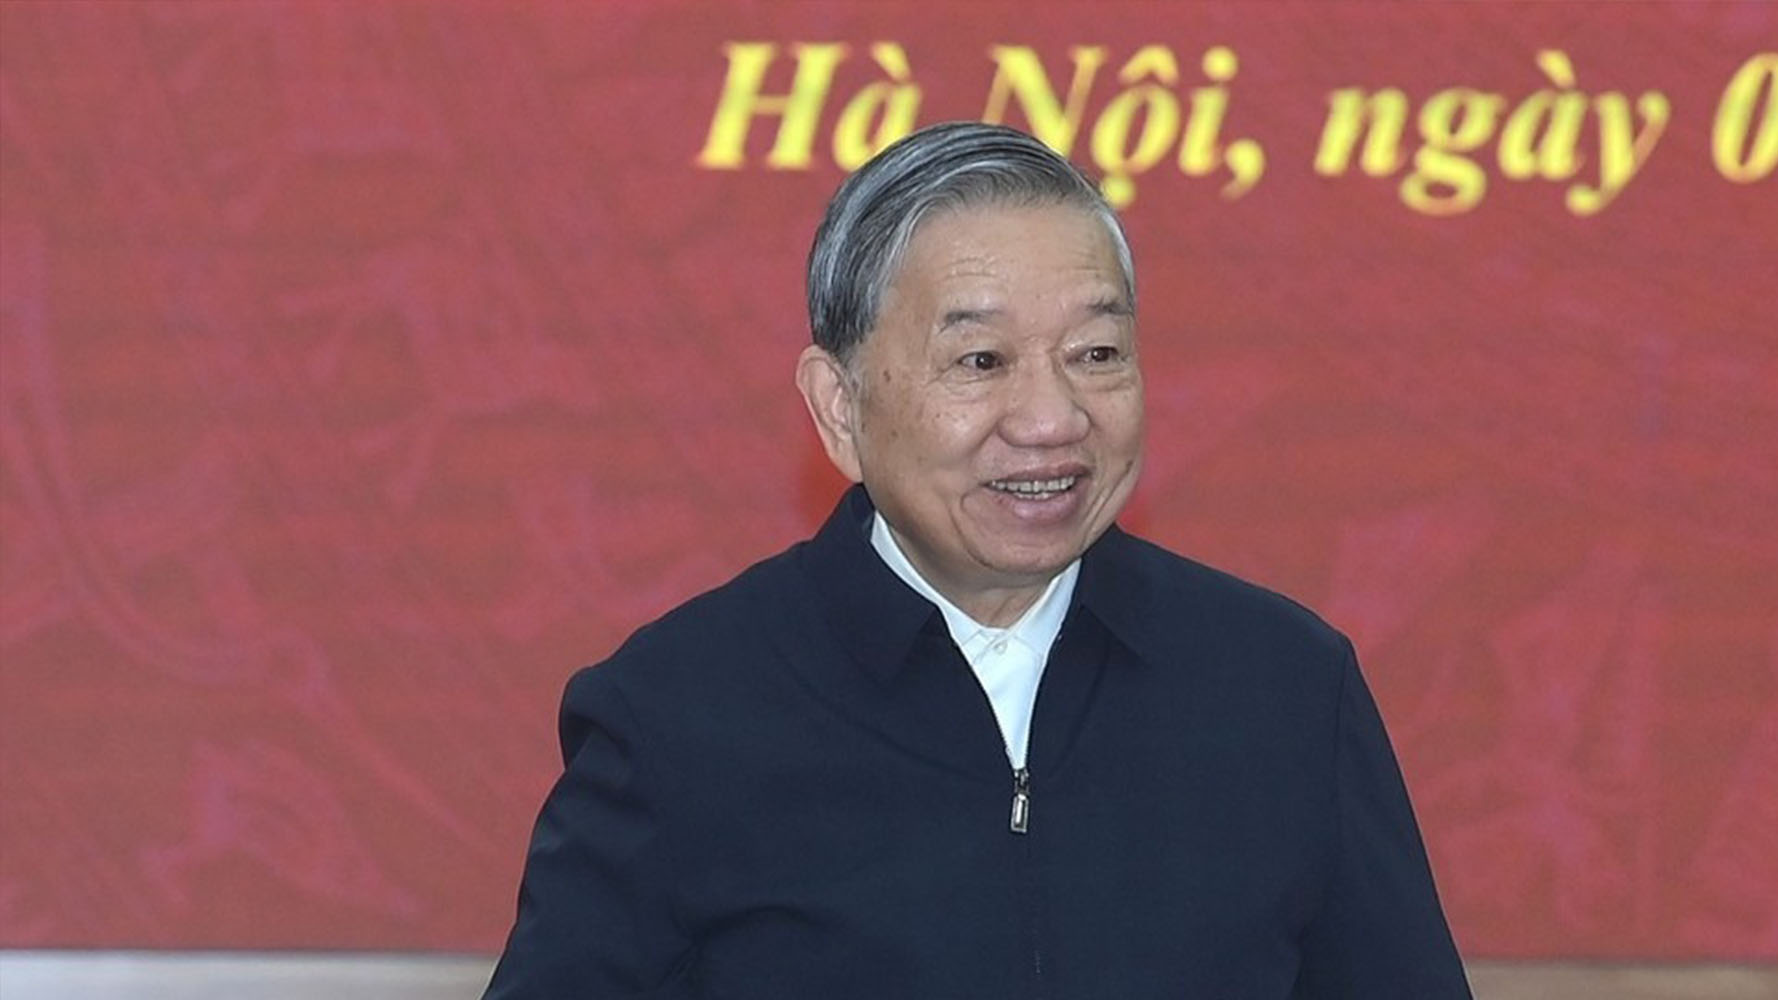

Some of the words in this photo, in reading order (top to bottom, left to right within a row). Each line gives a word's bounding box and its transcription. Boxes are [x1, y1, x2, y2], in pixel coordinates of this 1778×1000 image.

[698, 41, 922, 171] Hà
[978, 43, 1266, 210] Nội,
[1313, 49, 1671, 215] ngày
